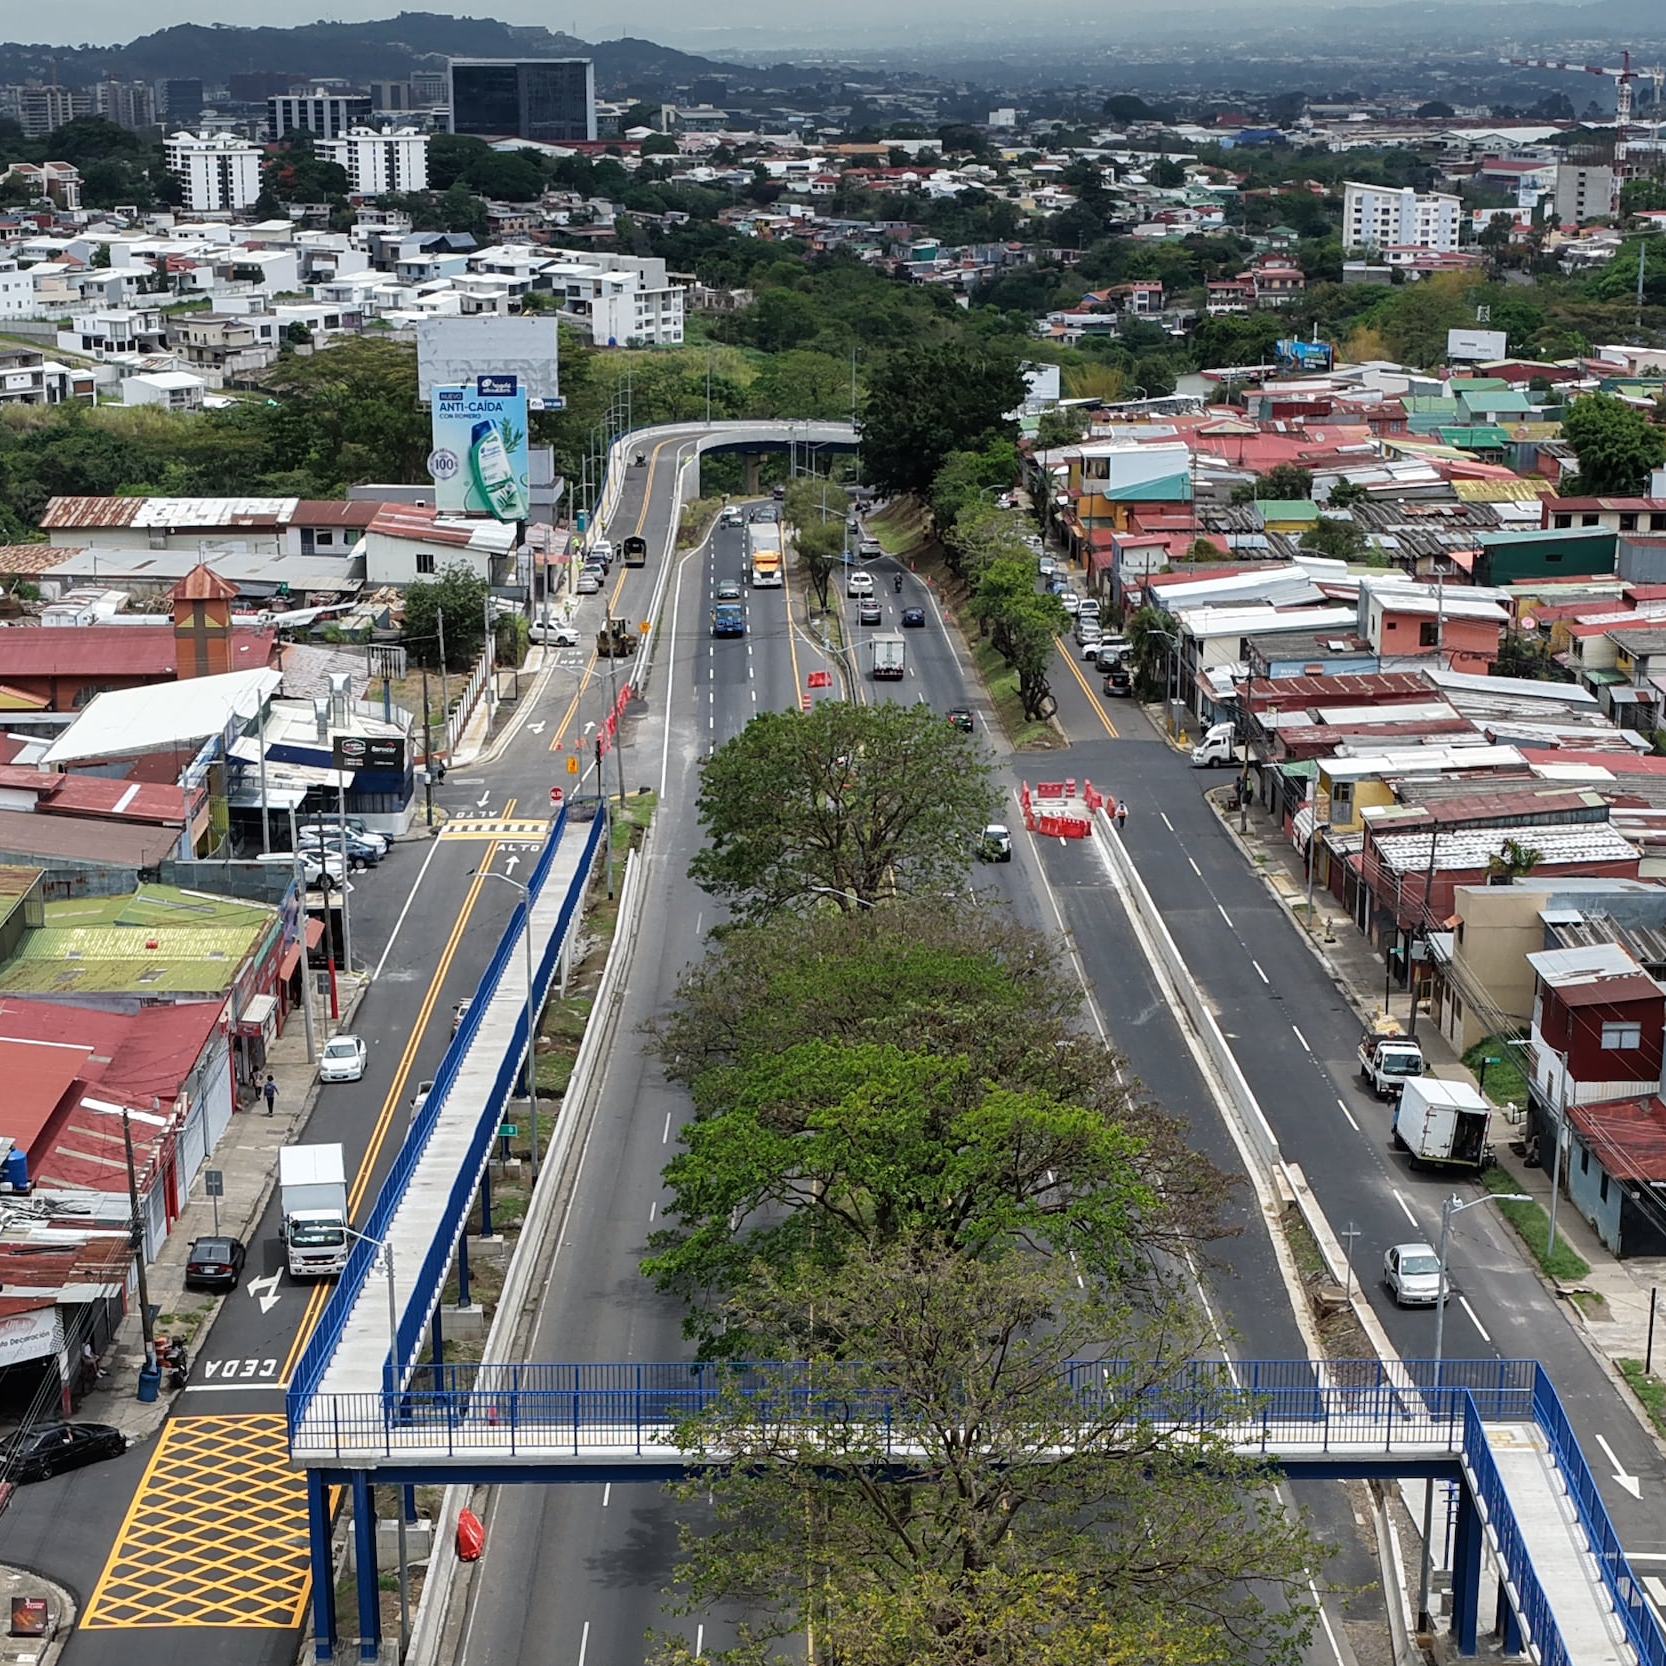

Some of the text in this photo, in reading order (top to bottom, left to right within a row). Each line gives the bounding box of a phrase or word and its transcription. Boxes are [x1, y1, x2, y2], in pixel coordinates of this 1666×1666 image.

[435, 458, 454, 470] 100
[455, 810, 498, 818] ALTO
[496, 844, 541, 852] ALTO
[10, 1330, 51, 1346] Decoración
[204, 1359, 277, 1378] CEDA
